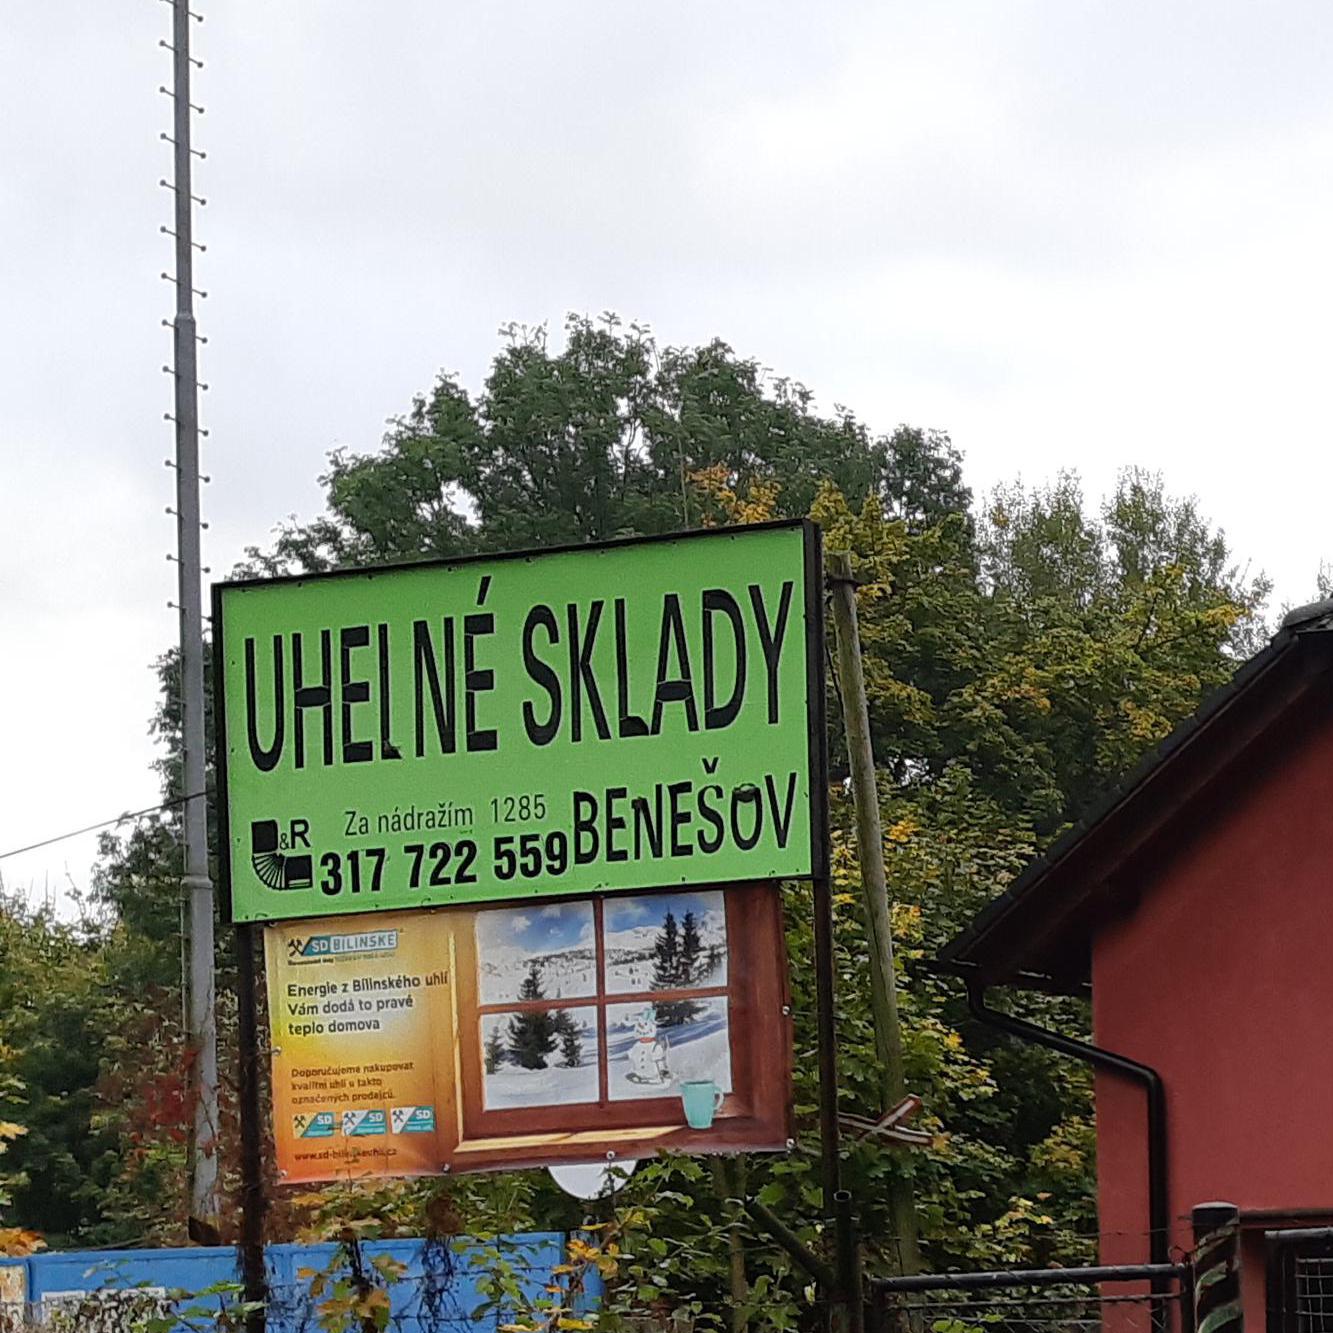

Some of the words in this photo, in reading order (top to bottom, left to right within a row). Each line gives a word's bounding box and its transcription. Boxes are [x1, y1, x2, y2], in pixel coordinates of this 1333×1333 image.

[245, 576, 498, 772] UHELNÉ
[522, 581, 794, 746] SKLADY
[344, 811, 369, 836] Za
[378, 802, 473, 834] nádražím
[491, 795, 546, 823] 1285
[573, 757, 796, 864] BENEŠOV
[320, 848, 386, 896] 317
[404, 840, 477, 888] 722
[494, 831, 567, 881] 559
[311, 939, 328, 952] SD
[287, 980, 338, 998] Energie
[342, 983, 349, 993] z
[353, 975, 421, 993] Bílinského
[425, 971, 448, 986] uhlí
[288, 1001, 318, 1016] Vám
[323, 999, 355, 1014] dodá
[359, 1000, 372, 1011] to
[377, 995, 413, 1012] pravé
[288, 1021, 324, 1038] teplo
[328, 1018, 380, 1033] domova
[317, 1115, 332, 1125] SD
[369, 1112, 383, 1122] SD
[416, 1109, 431, 1119] SD
